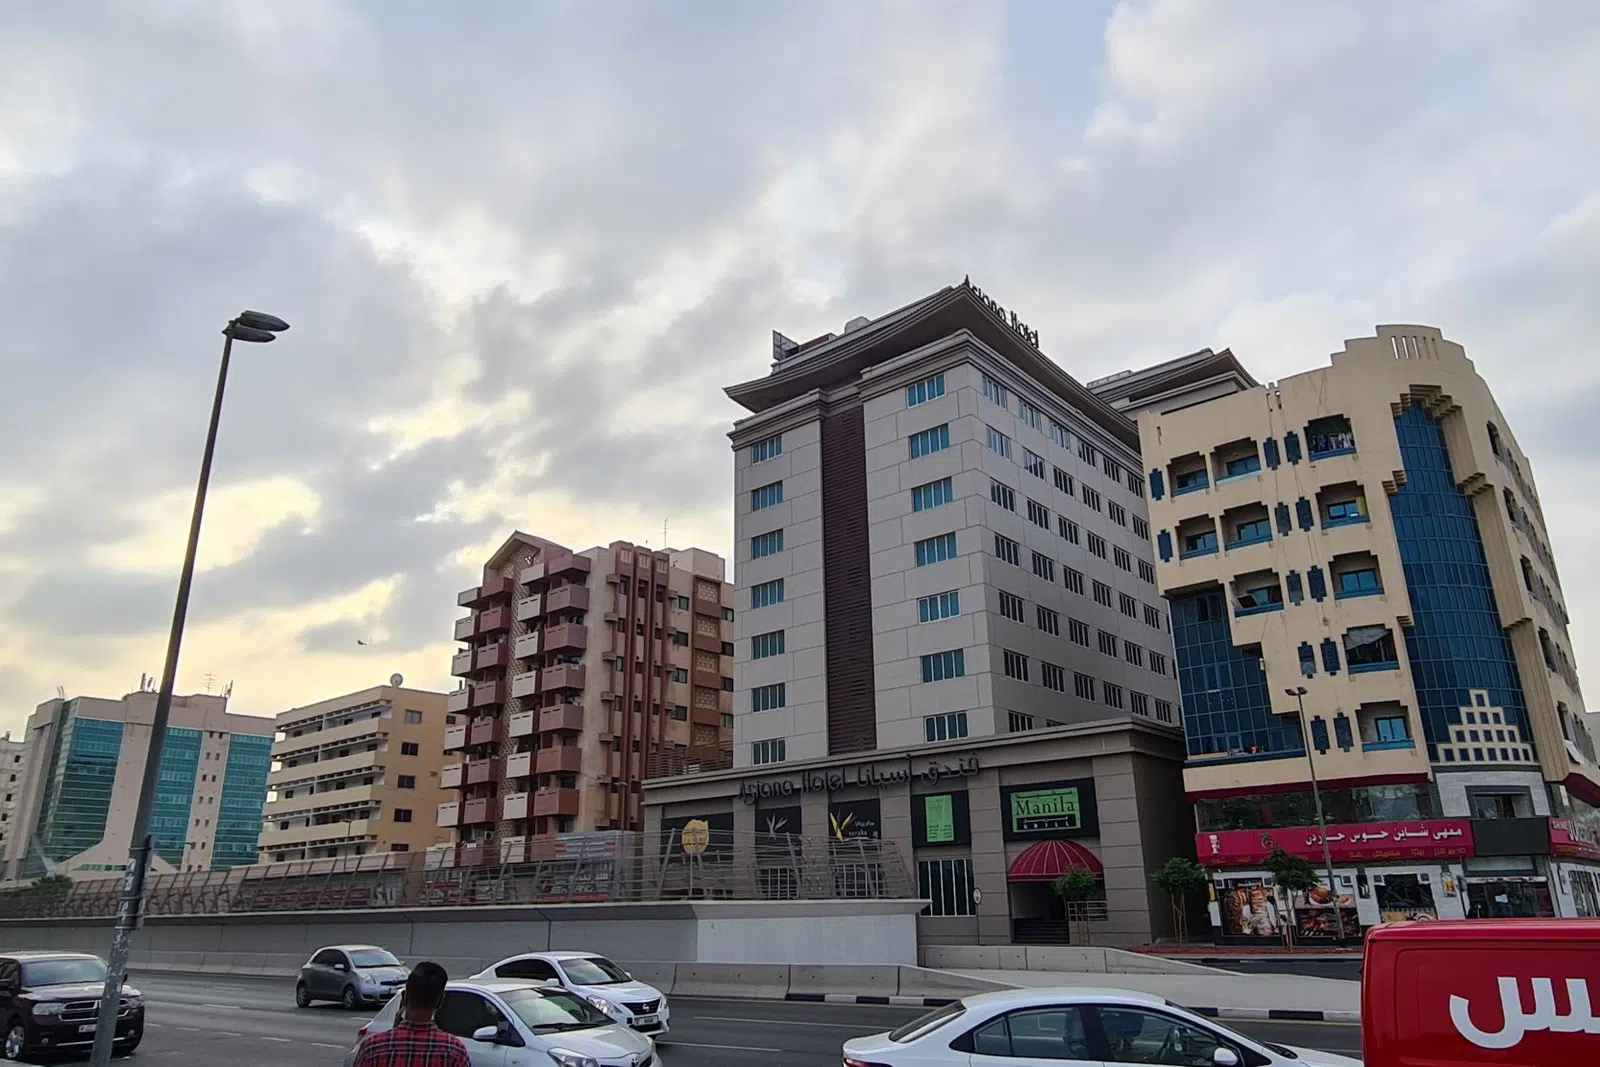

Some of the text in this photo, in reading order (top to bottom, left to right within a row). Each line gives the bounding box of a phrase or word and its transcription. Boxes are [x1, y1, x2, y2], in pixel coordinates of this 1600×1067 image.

[1010, 310, 1039, 348] Hotel
[738, 766, 846, 805] Asiana Hotel
[920, 751, 980, 787] فندق
[1016, 796, 1075, 816] Manila
